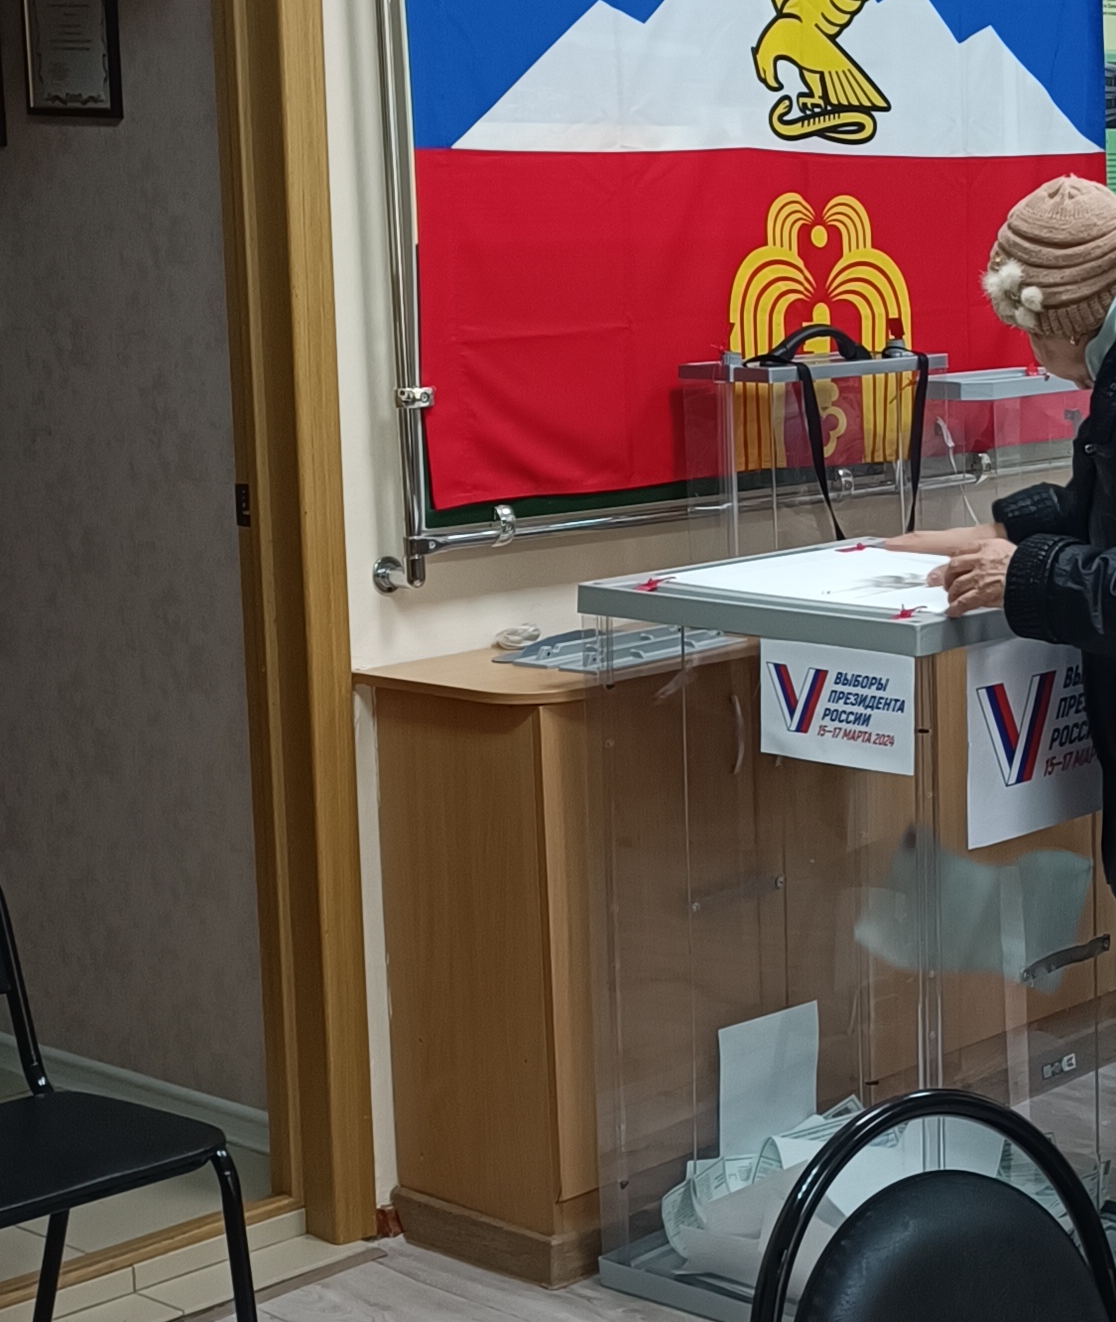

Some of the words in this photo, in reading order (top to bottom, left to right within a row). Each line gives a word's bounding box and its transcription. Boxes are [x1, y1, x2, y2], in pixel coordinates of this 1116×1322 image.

[833, 671, 890, 692] ВЫБОРЫ
[827, 689, 906, 714] ПРЕЗИДЕНТА
[821, 707, 872, 727] РОССИИ
[842, 728, 872, 744] МАРТА
[872, 732, 895, 748] 2024
[1048, 719, 1091, 751] РОСС
